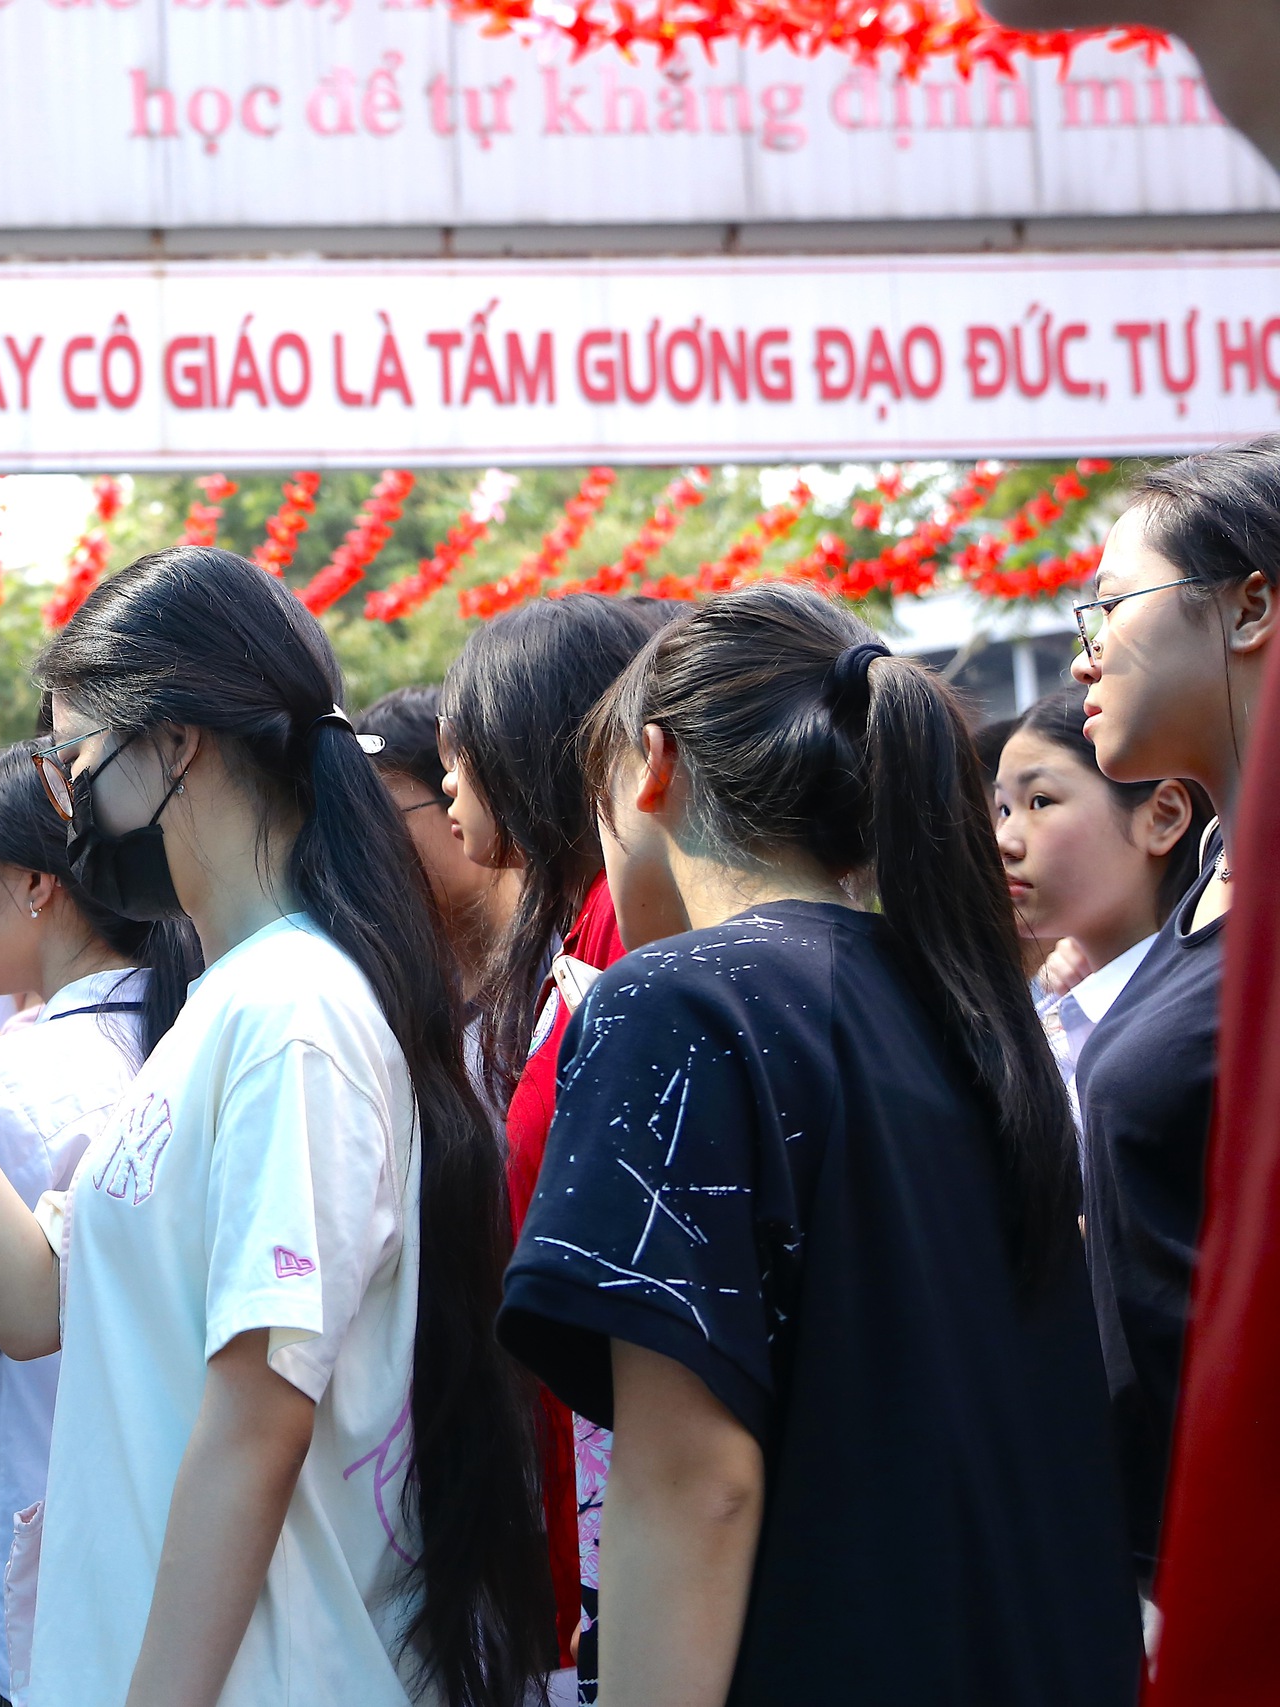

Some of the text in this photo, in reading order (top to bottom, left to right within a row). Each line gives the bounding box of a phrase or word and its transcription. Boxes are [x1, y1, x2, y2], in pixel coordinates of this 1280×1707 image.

[129, 67, 282, 156] học
[304, 48, 404, 137] để
[425, 72, 516, 152] tự
[61, 312, 143, 412] CÔ
[164, 311, 312, 409] GIÁO
[332, 309, 415, 409] LÀ
[426, 296, 555, 407] TẤM
[576, 314, 794, 405] GƯƠNG
[814, 322, 945, 421] ĐẠO
[965, 301, 1107, 402] ĐỨC,
[1114, 305, 1200, 419] TỰ
